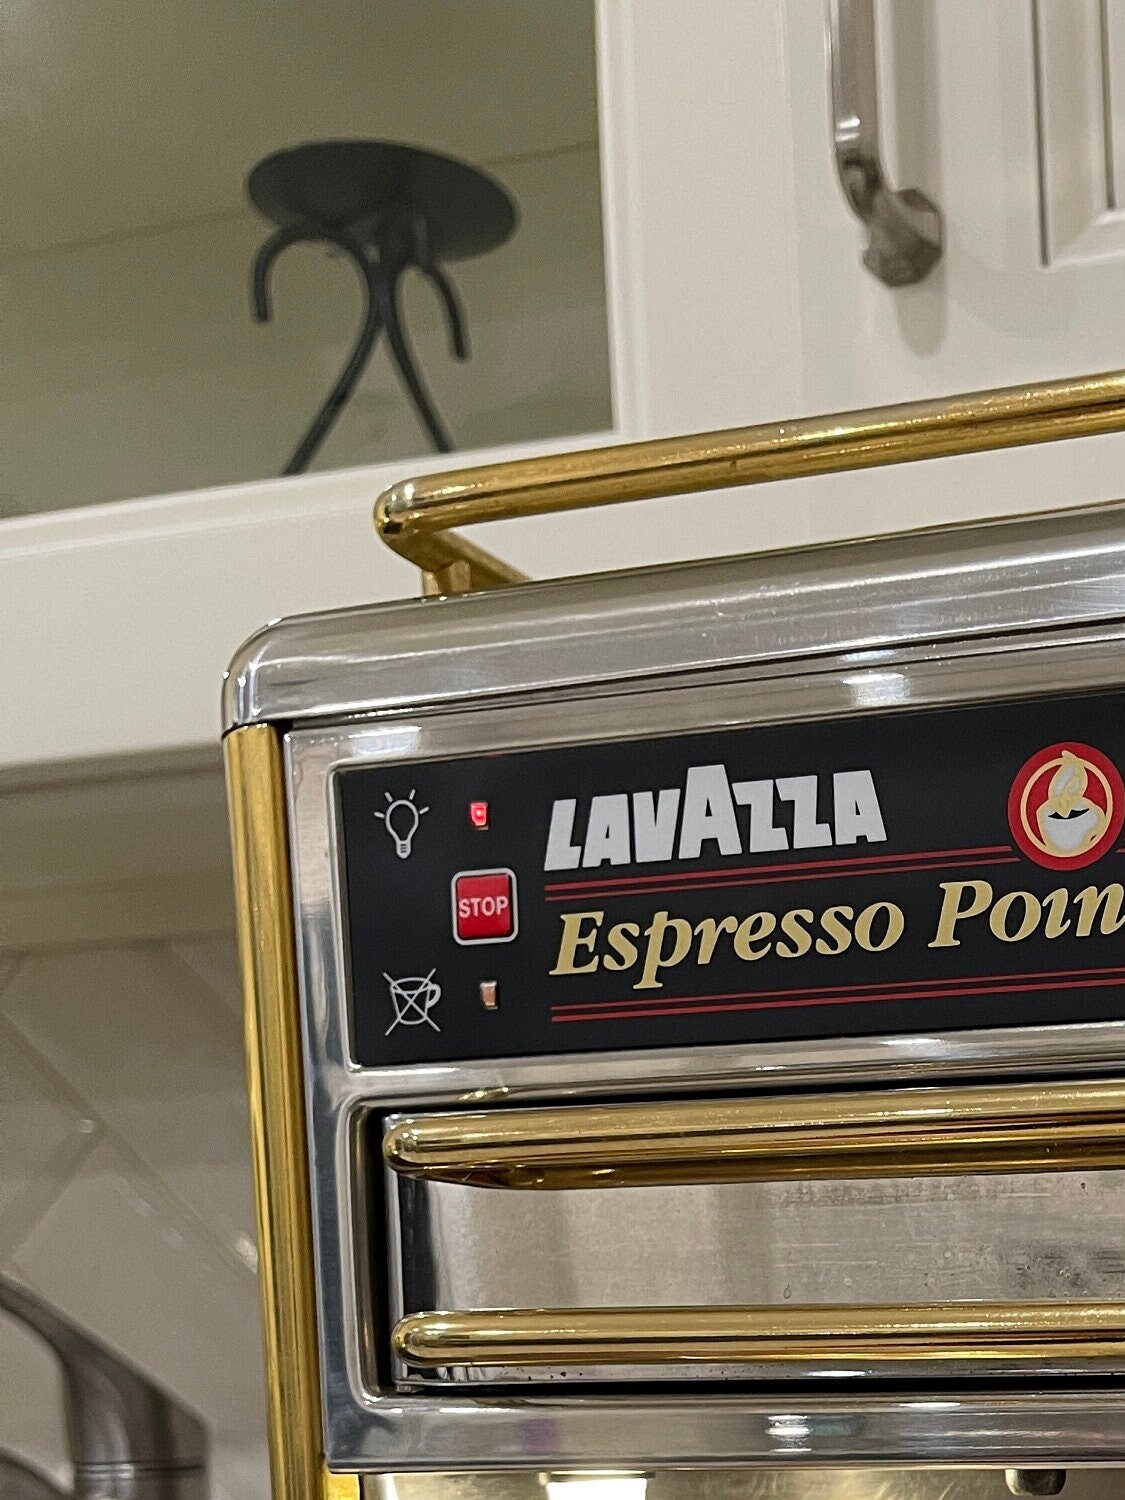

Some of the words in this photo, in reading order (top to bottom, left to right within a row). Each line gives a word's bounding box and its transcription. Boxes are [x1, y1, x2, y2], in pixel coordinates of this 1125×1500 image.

[544, 764, 887, 871] LAVAZZA
[457, 896, 510, 918] STOP
[549, 901, 905, 989] Espresso
